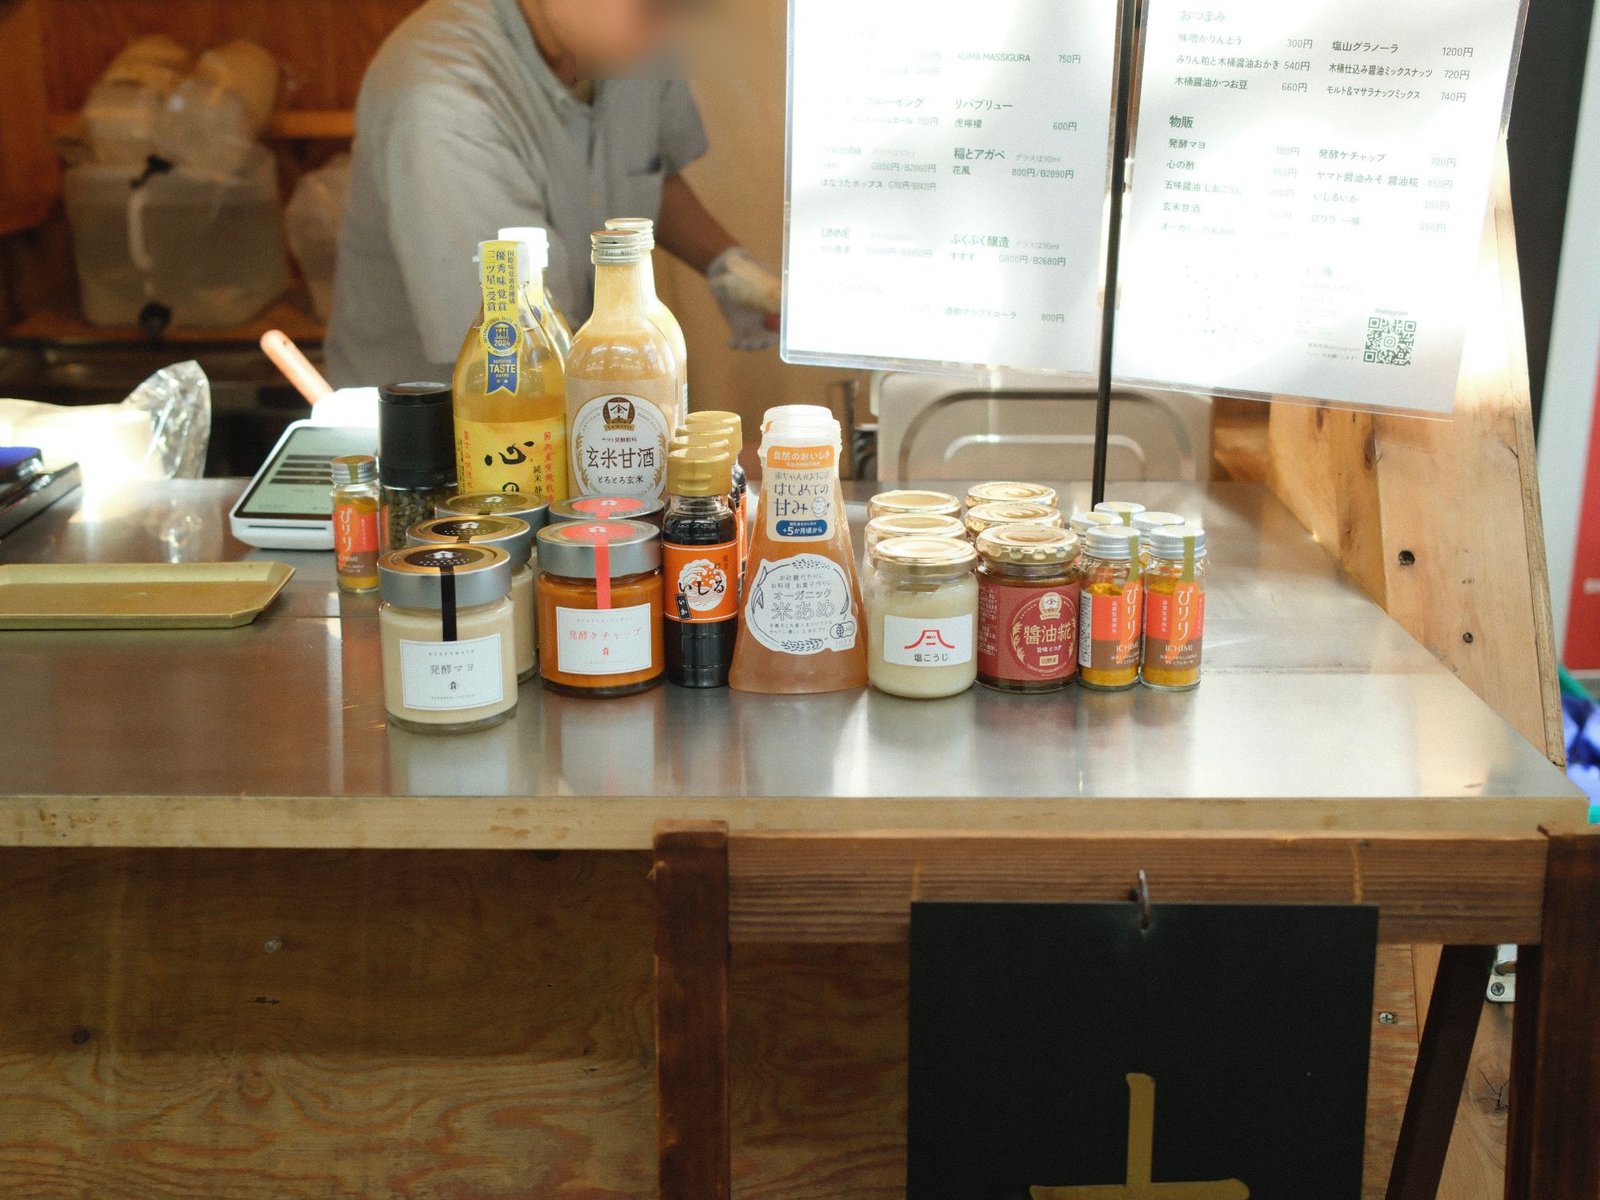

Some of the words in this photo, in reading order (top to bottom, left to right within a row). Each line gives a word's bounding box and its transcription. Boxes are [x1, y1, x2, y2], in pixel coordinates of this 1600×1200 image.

[1179, 9, 1226, 24] おつまみ
[1286, 38, 1313, 50] 300円
[1331, 40, 1399, 54] 塩山グラノーラ
[1442, 47, 1474, 58] 1200円
[1058, 54, 1081, 65] 750円
[1284, 60, 1310, 72] 540円
[1444, 69, 1470, 81] 720円
[1281, 82, 1307, 93] 660円
[1440, 91, 1466, 102] 740円
[1053, 121, 1077, 132] 600円
[1169, 115, 1194, 129] 物販
[1168, 138, 1206, 150] 発酵マヨ
[953, 146, 1006, 160] 稲とアガベ
[1318, 149, 1386, 163] 発酵ケチャップ
[1166, 160, 1195, 171] 心の酢
[1164, 179, 1201, 192] 五味醤油
[1162, 201, 1200, 214] 玄米甘酒
[494, 339, 511, 347] 2024
[489, 364, 516, 374] TASTE
[586, 446, 655, 469] 玄米甘酒
[597, 475, 644, 485] とろとろ玄米
[774, 482, 829, 497] はじめての
[774, 498, 808, 517] 甘み
[678, 579, 725, 596] いしる
[773, 588, 832, 602] オーガニック
[771, 599, 836, 621] 米あめ
[914, 652, 949, 662] 塩こうじ
